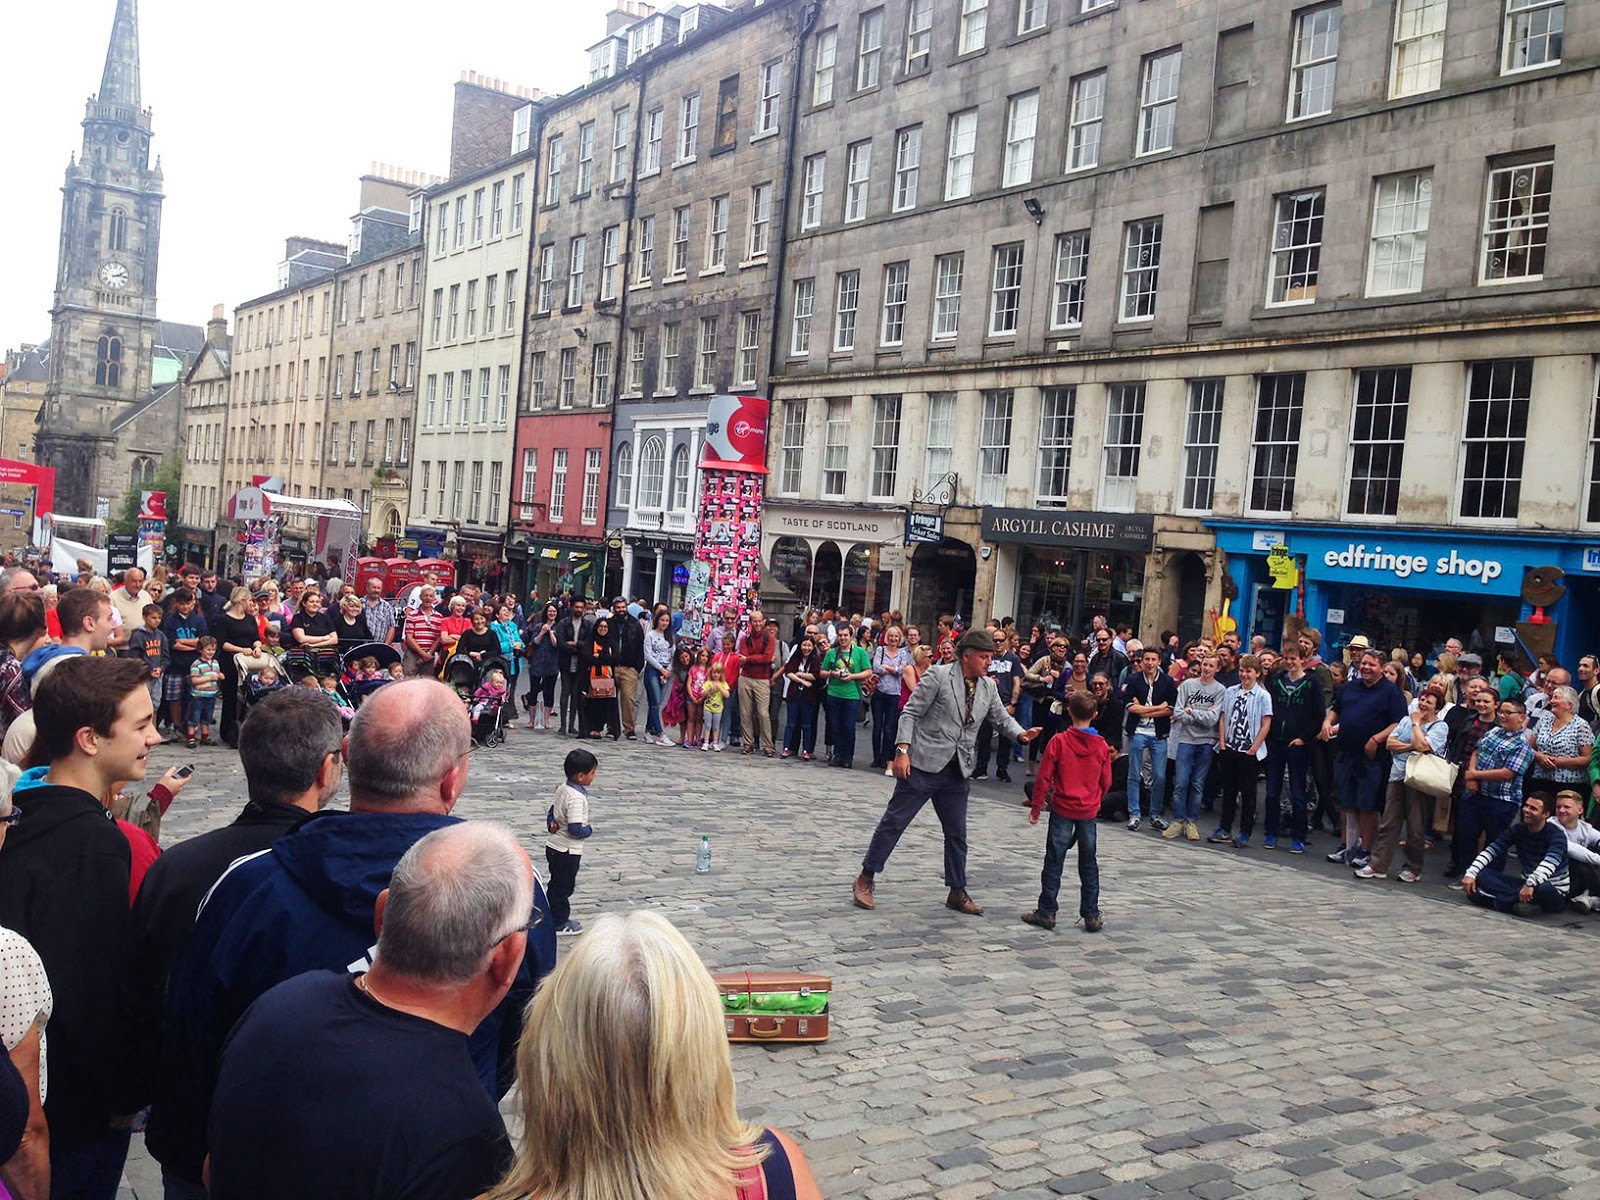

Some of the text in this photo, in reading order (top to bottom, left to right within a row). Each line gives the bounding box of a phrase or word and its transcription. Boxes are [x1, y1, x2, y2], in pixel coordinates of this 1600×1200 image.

[782, 517, 879, 533] TASTE OF SCOTLAND
[915, 514, 935, 527] fringe
[992, 517, 1047, 535] ARGYLL
[911, 526, 940, 541] Ticket Sales
[647, 540, 694, 551] BAY OF BENGA
[1324, 544, 1502, 585] edfringe shop
